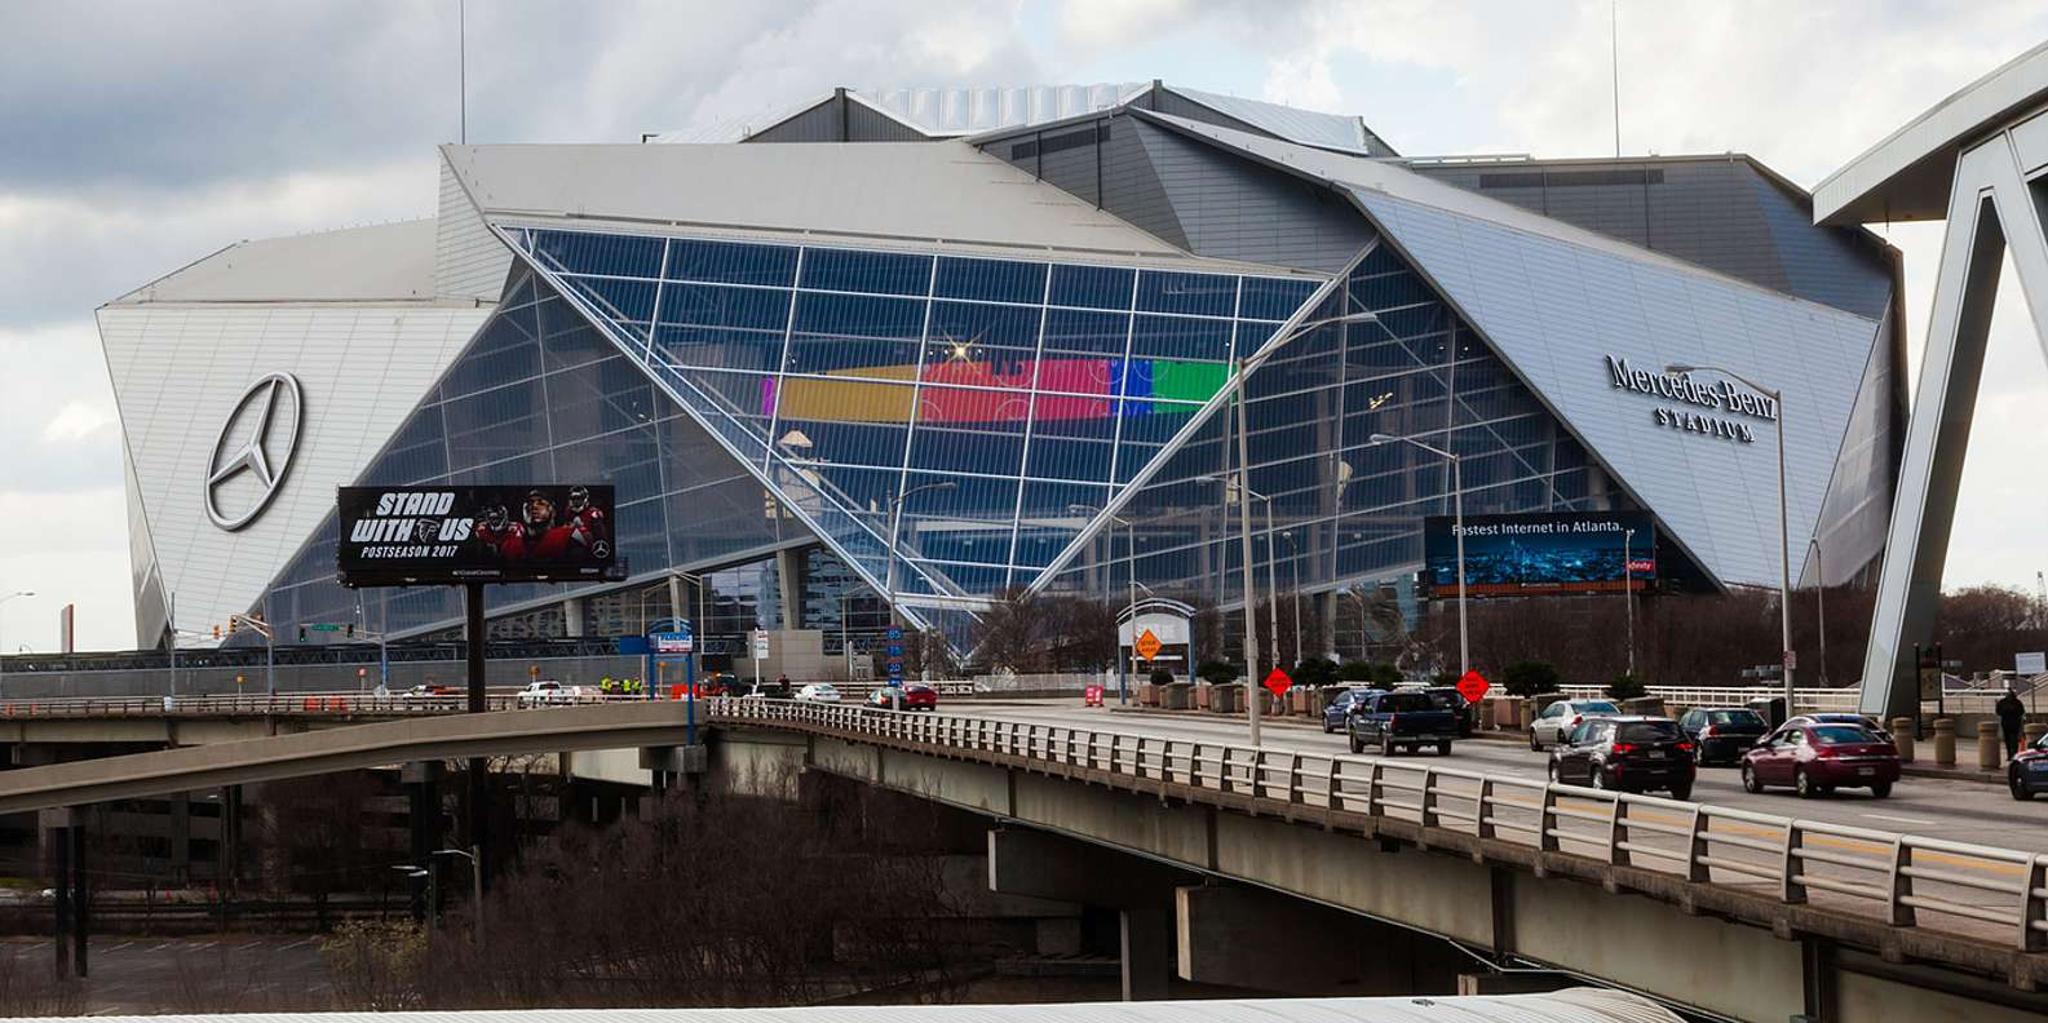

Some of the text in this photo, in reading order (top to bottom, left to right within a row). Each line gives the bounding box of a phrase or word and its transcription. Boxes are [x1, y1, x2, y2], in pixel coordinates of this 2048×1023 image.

[1605, 354, 1777, 421] Mercedes-Benz
[1654, 406, 1755, 442] STADIUM
[376, 493, 455, 516] STAND
[351, 518, 474, 543] WITH US
[1501, 522, 1554, 535] Internet
[1557, 522, 1570, 534] in
[1573, 521, 1624, 533] Atlanta.
[361, 545, 459, 559] POSTSEASON 2017
